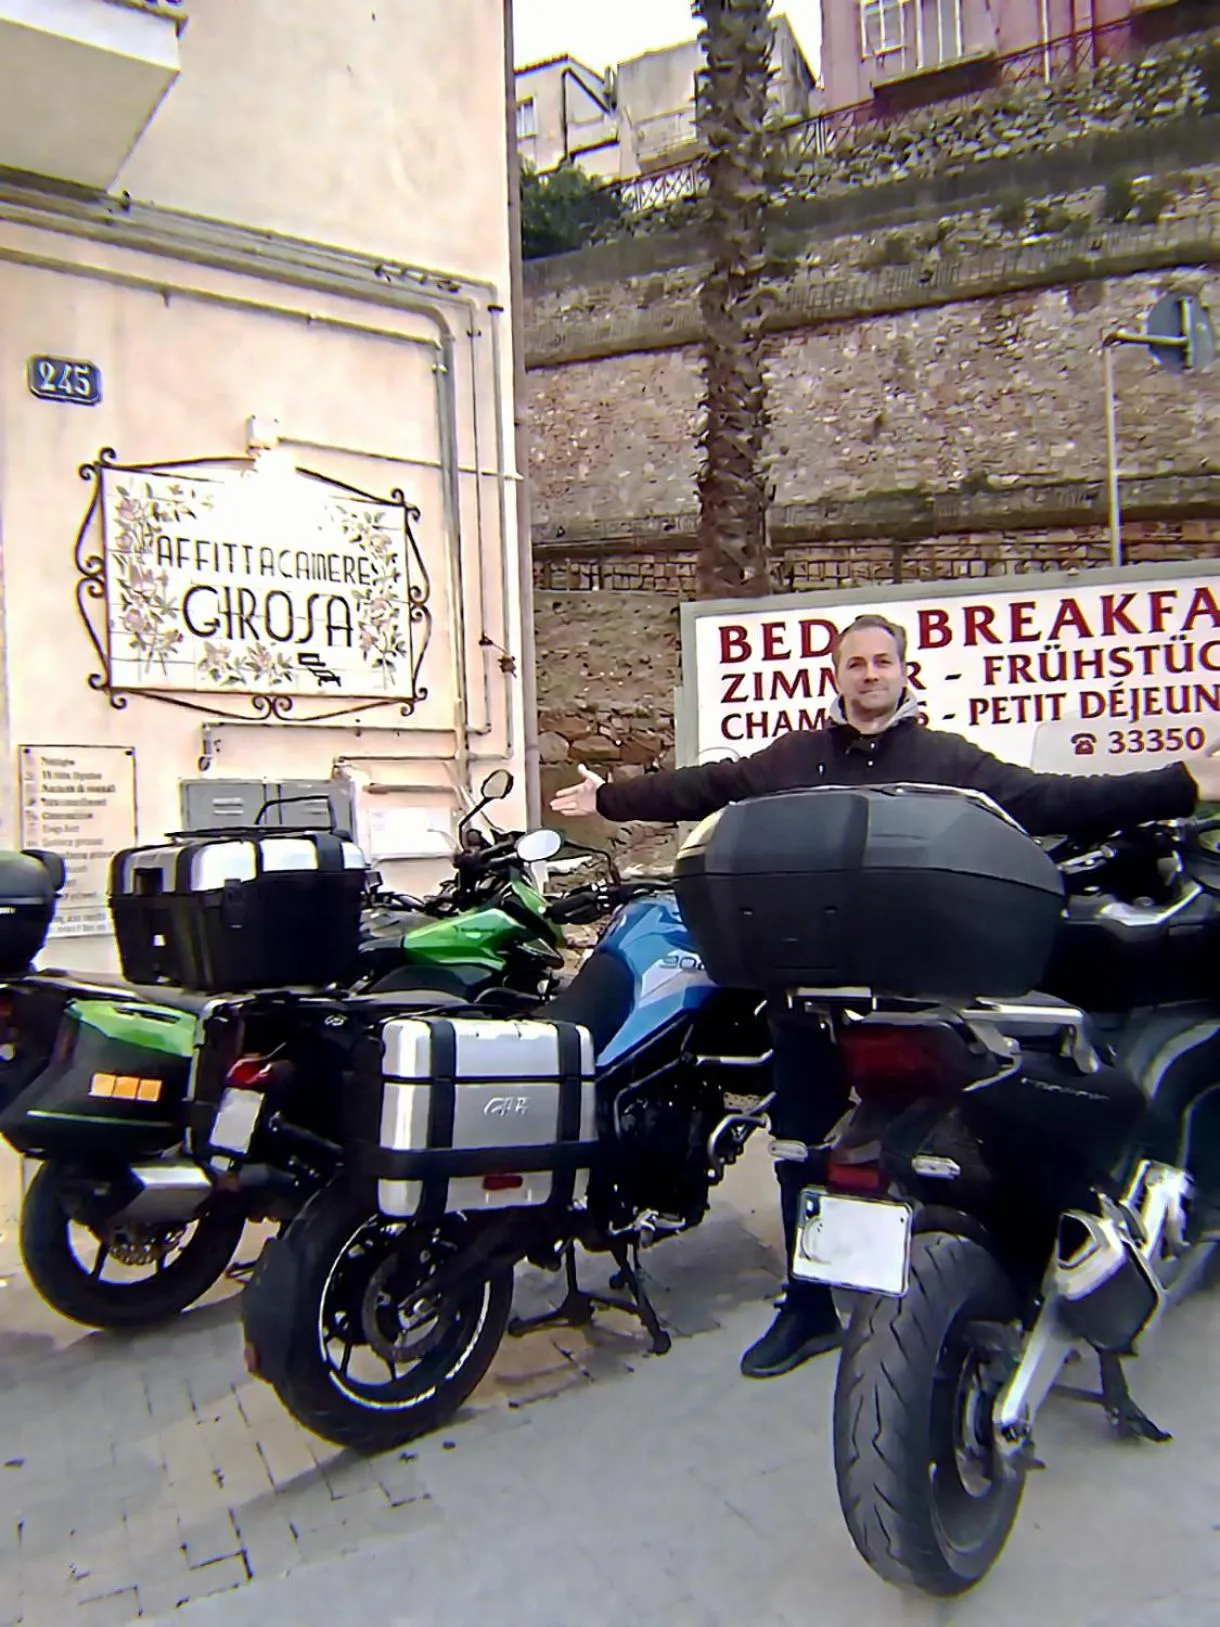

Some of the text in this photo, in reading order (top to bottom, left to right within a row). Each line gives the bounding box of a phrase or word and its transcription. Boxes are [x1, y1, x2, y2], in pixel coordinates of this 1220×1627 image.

[39, 361, 91, 396] 245
[156, 535, 371, 586] AFFITTACAMERE
[182, 584, 353, 648] GIROSA
[718, 586, 1220, 664] BED BREAKFA
[968, 692, 1067, 727] PETIT
[1078, 680, 1220, 724] DÉJEUN
[1107, 726, 1206, 755] 33350
